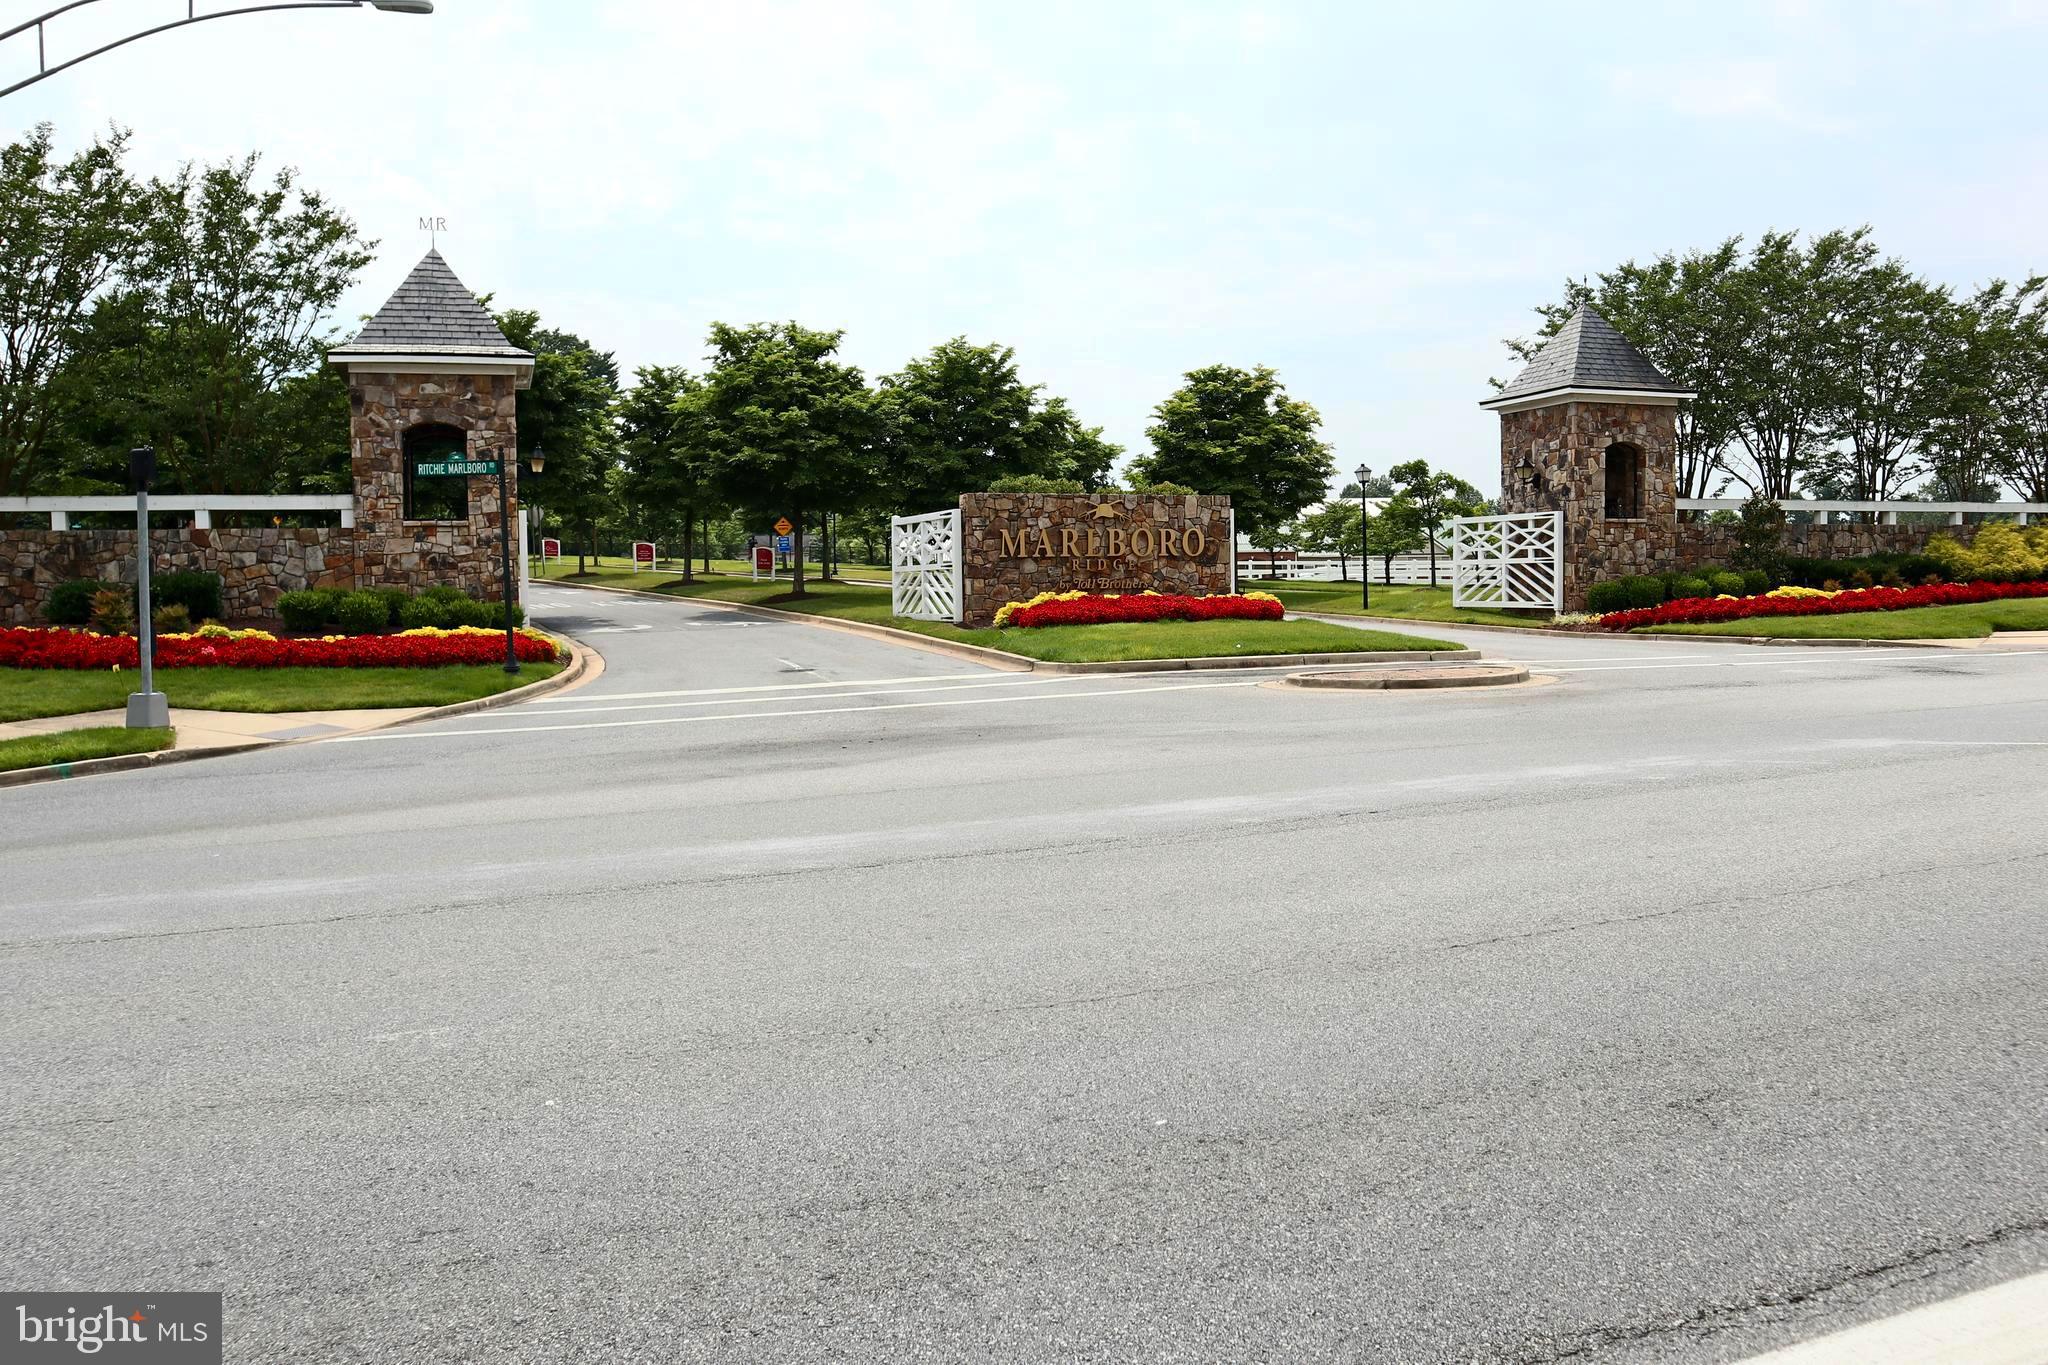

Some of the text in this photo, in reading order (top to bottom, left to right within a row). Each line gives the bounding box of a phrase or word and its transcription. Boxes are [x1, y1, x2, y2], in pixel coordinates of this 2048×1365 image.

[417, 463, 446, 475] RITCHIE
[448, 462, 487, 474] MARLBORO
[1000, 527, 1205, 558] MARLBORO
[1072, 559, 1136, 571] RIDGE
[1060, 577, 1149, 592] by Toll Brothers
